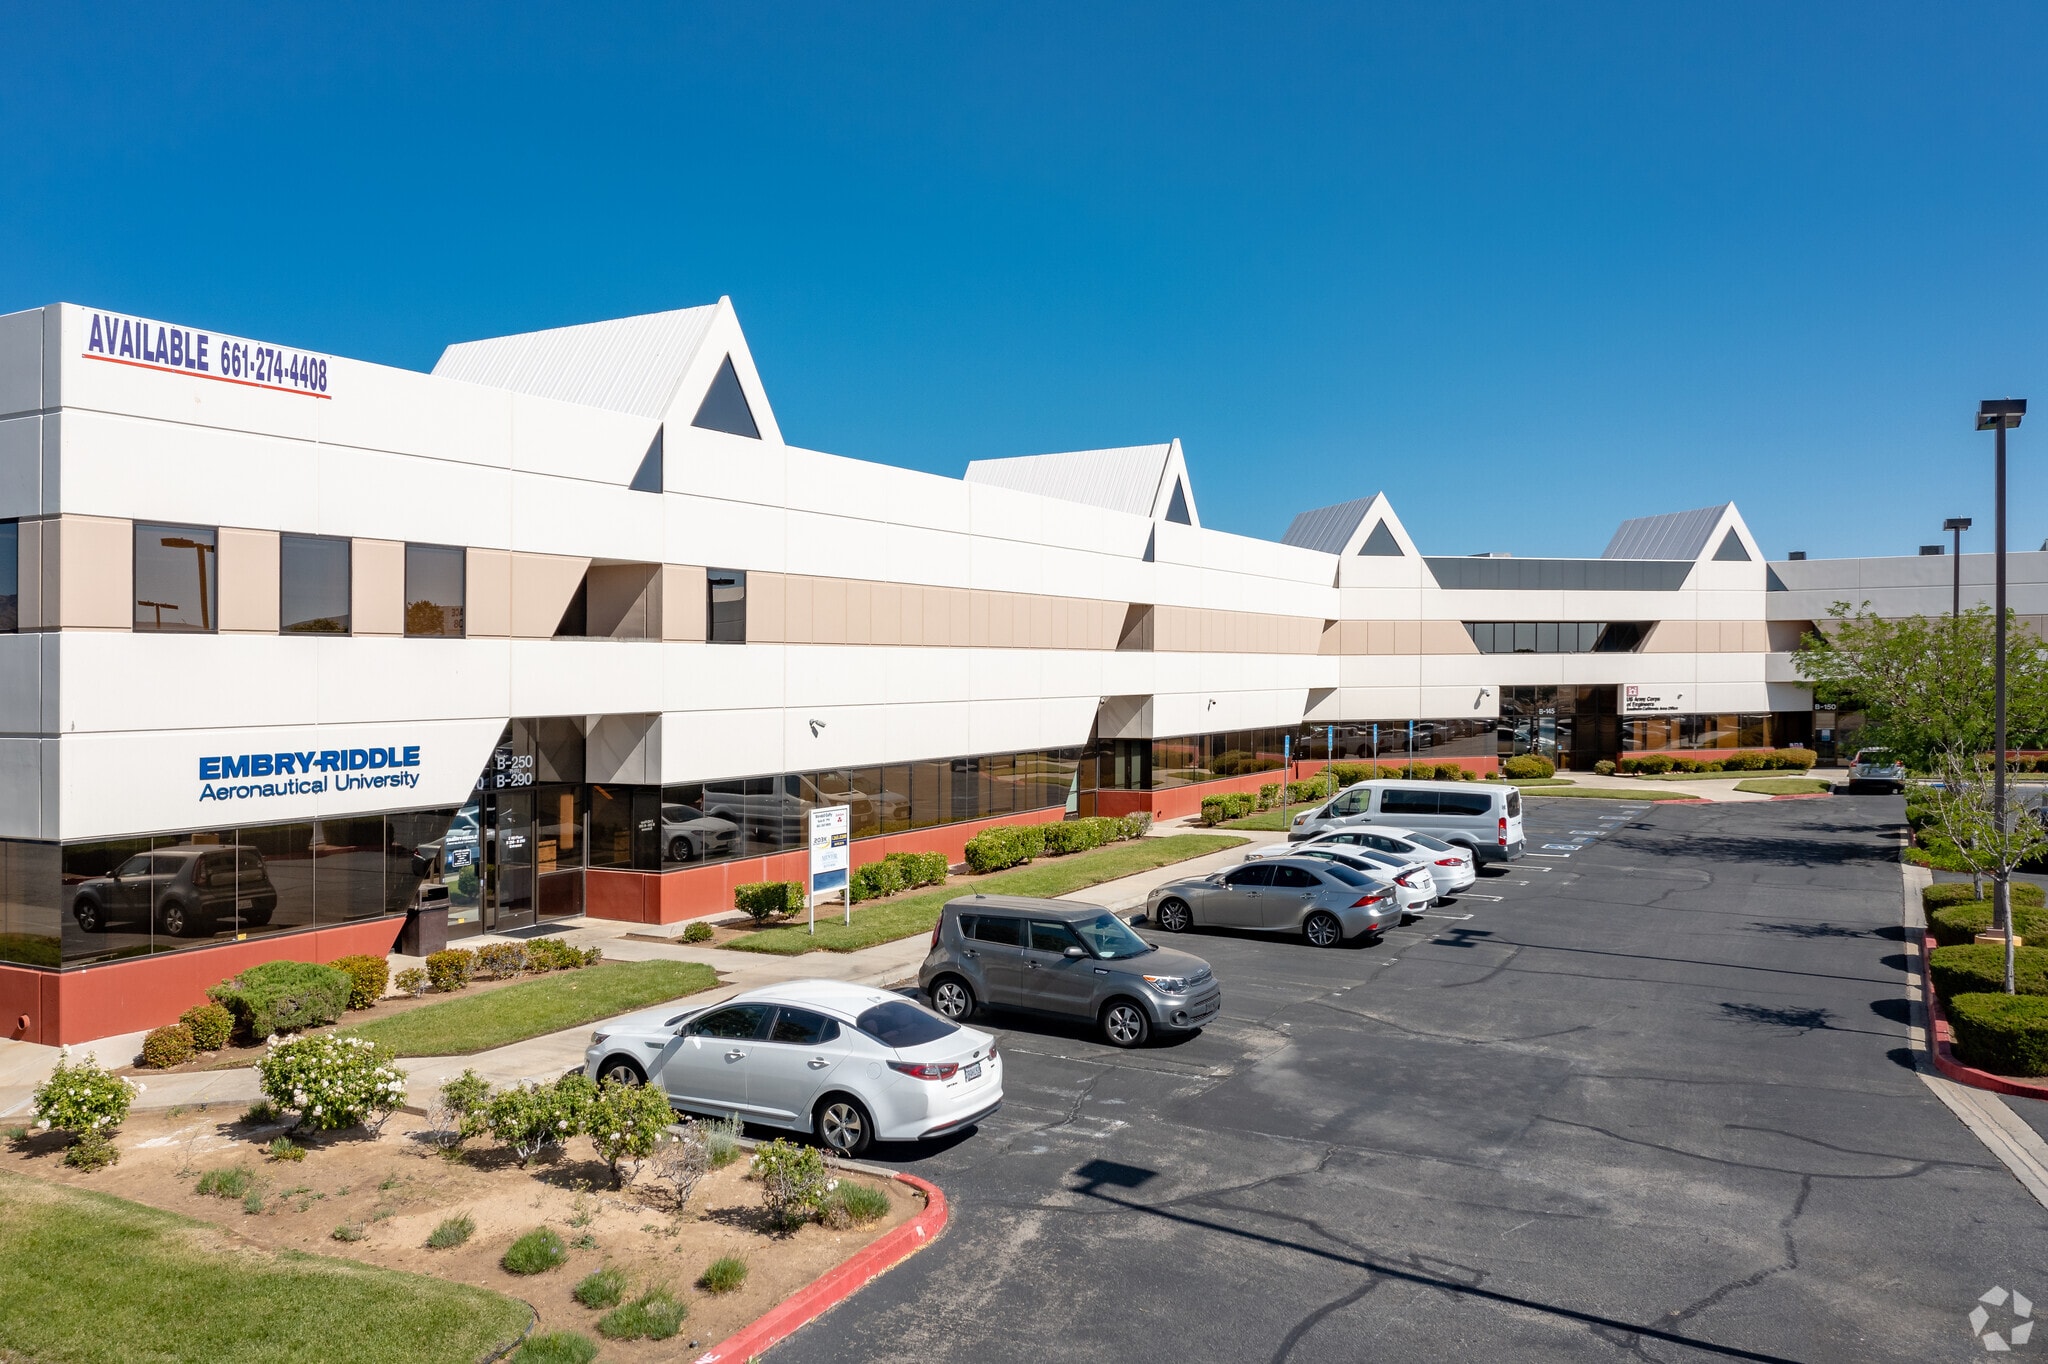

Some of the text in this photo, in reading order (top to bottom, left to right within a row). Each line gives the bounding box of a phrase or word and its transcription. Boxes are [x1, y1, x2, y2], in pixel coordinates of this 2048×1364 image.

[88, 313, 328, 393] AVAILABLE 661-274-4408
[199, 746, 421, 780] EMBRY-RIDDLE
[497, 755, 532, 770] B-250
[199, 770, 420, 802] Aeronautical University
[496, 772, 532, 788] B-290
